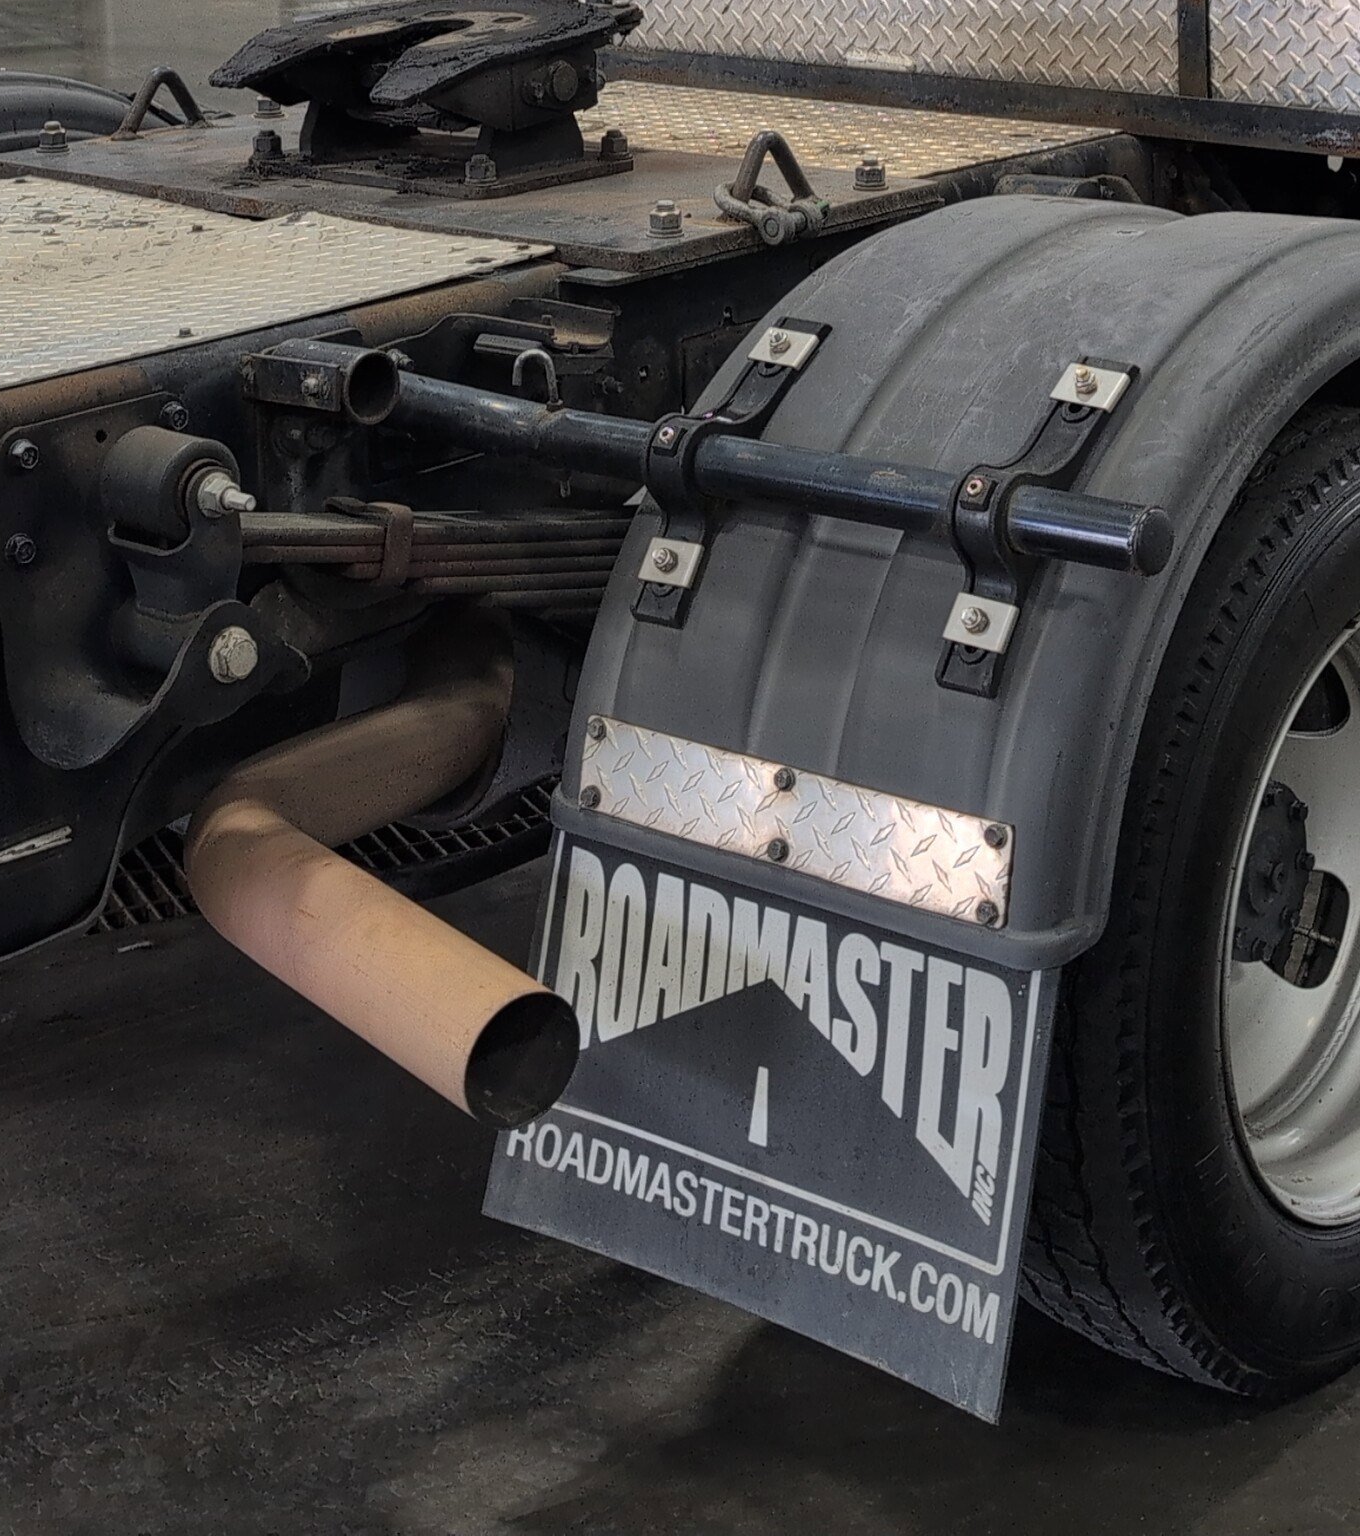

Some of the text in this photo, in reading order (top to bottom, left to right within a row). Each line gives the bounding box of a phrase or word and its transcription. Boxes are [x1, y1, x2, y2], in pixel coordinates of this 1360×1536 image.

[554, 845, 1012, 1199] ROADMASTER
[505, 1120, 1000, 1345] ROADMASTERTRUCK.COM
[971, 1164, 996, 1226] INC
